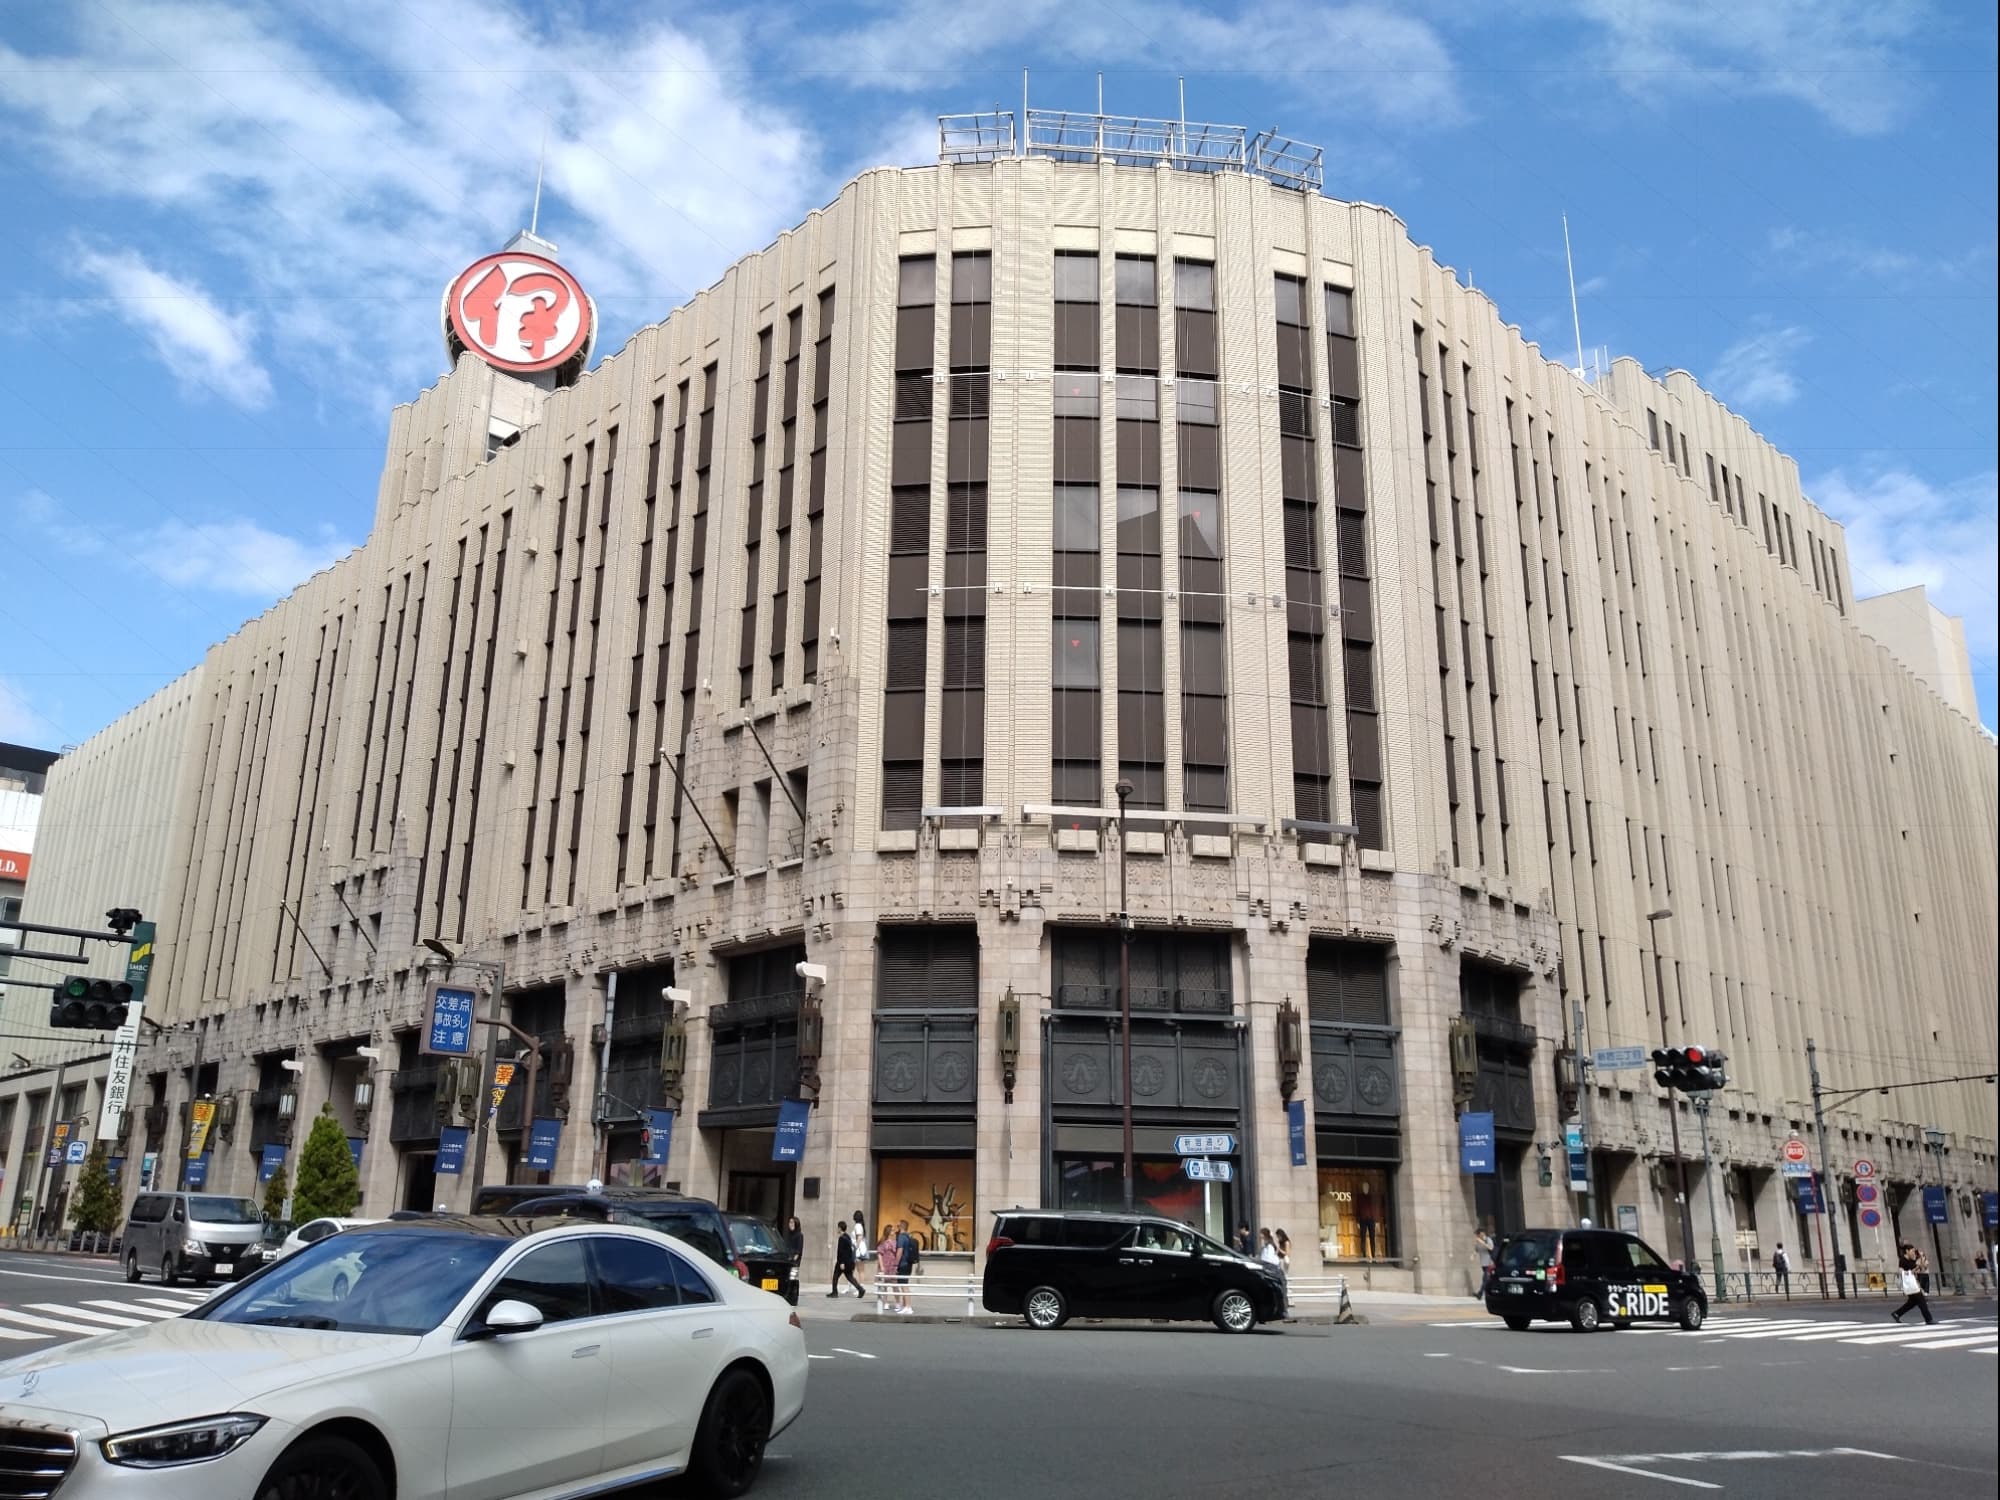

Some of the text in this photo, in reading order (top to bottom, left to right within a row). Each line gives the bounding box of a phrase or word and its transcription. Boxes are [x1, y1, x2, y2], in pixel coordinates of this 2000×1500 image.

[436, 995, 470, 1012] 交差点
[435, 1012, 468, 1029] 事故多し
[107, 1025, 135, 1114] 三井住友銀行
